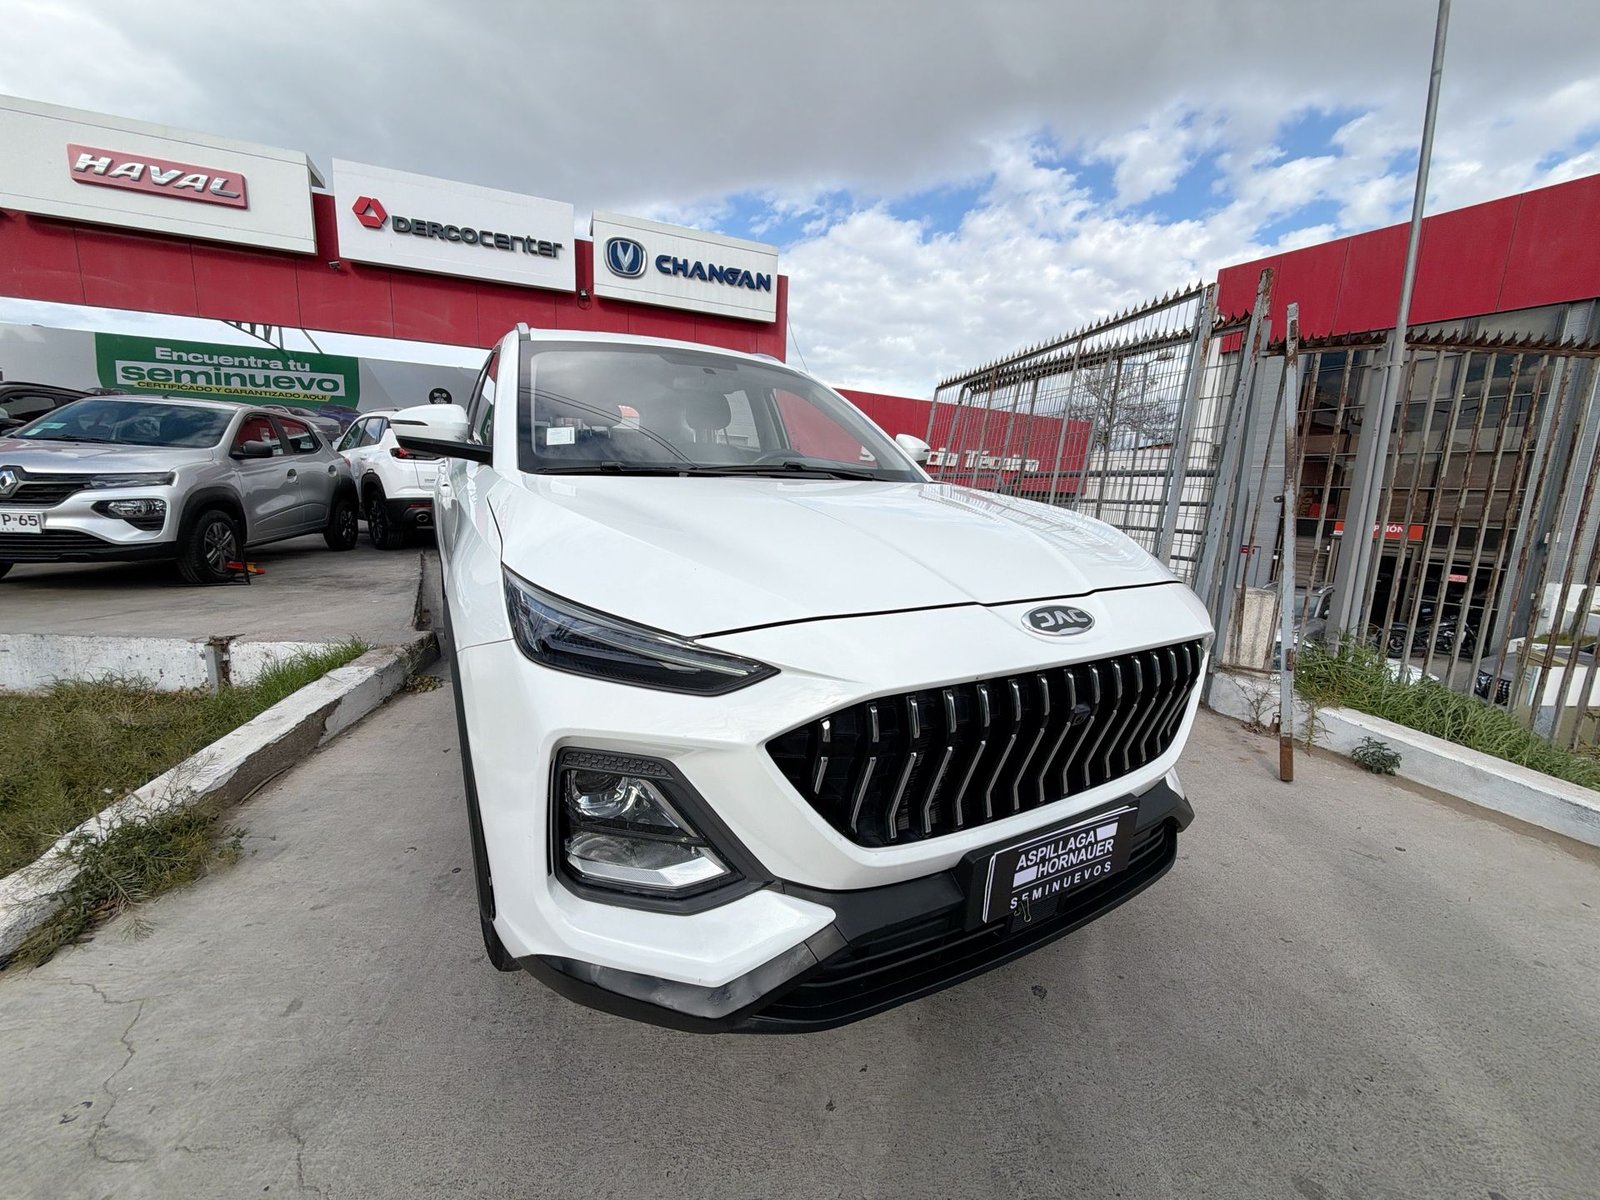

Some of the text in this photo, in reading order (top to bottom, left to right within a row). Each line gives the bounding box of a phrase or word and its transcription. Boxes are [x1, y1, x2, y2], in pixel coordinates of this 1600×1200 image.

[73, 153, 241, 199] HAVAL
[655, 254, 771, 292] CHANGAN
[155, 346, 310, 372] Encuentra tu
[121, 365, 340, 393] seminuevo
[137, 381, 213, 393] CERTIFICADO
[224, 387, 301, 400] GARANTIZADO
[1035, 609, 1089, 628] JAC
[1015, 829, 1095, 871] ASPILLAGA
[1037, 838, 1115, 878] HORNAUER
[1009, 861, 1112, 910] SEMINUEVOS
